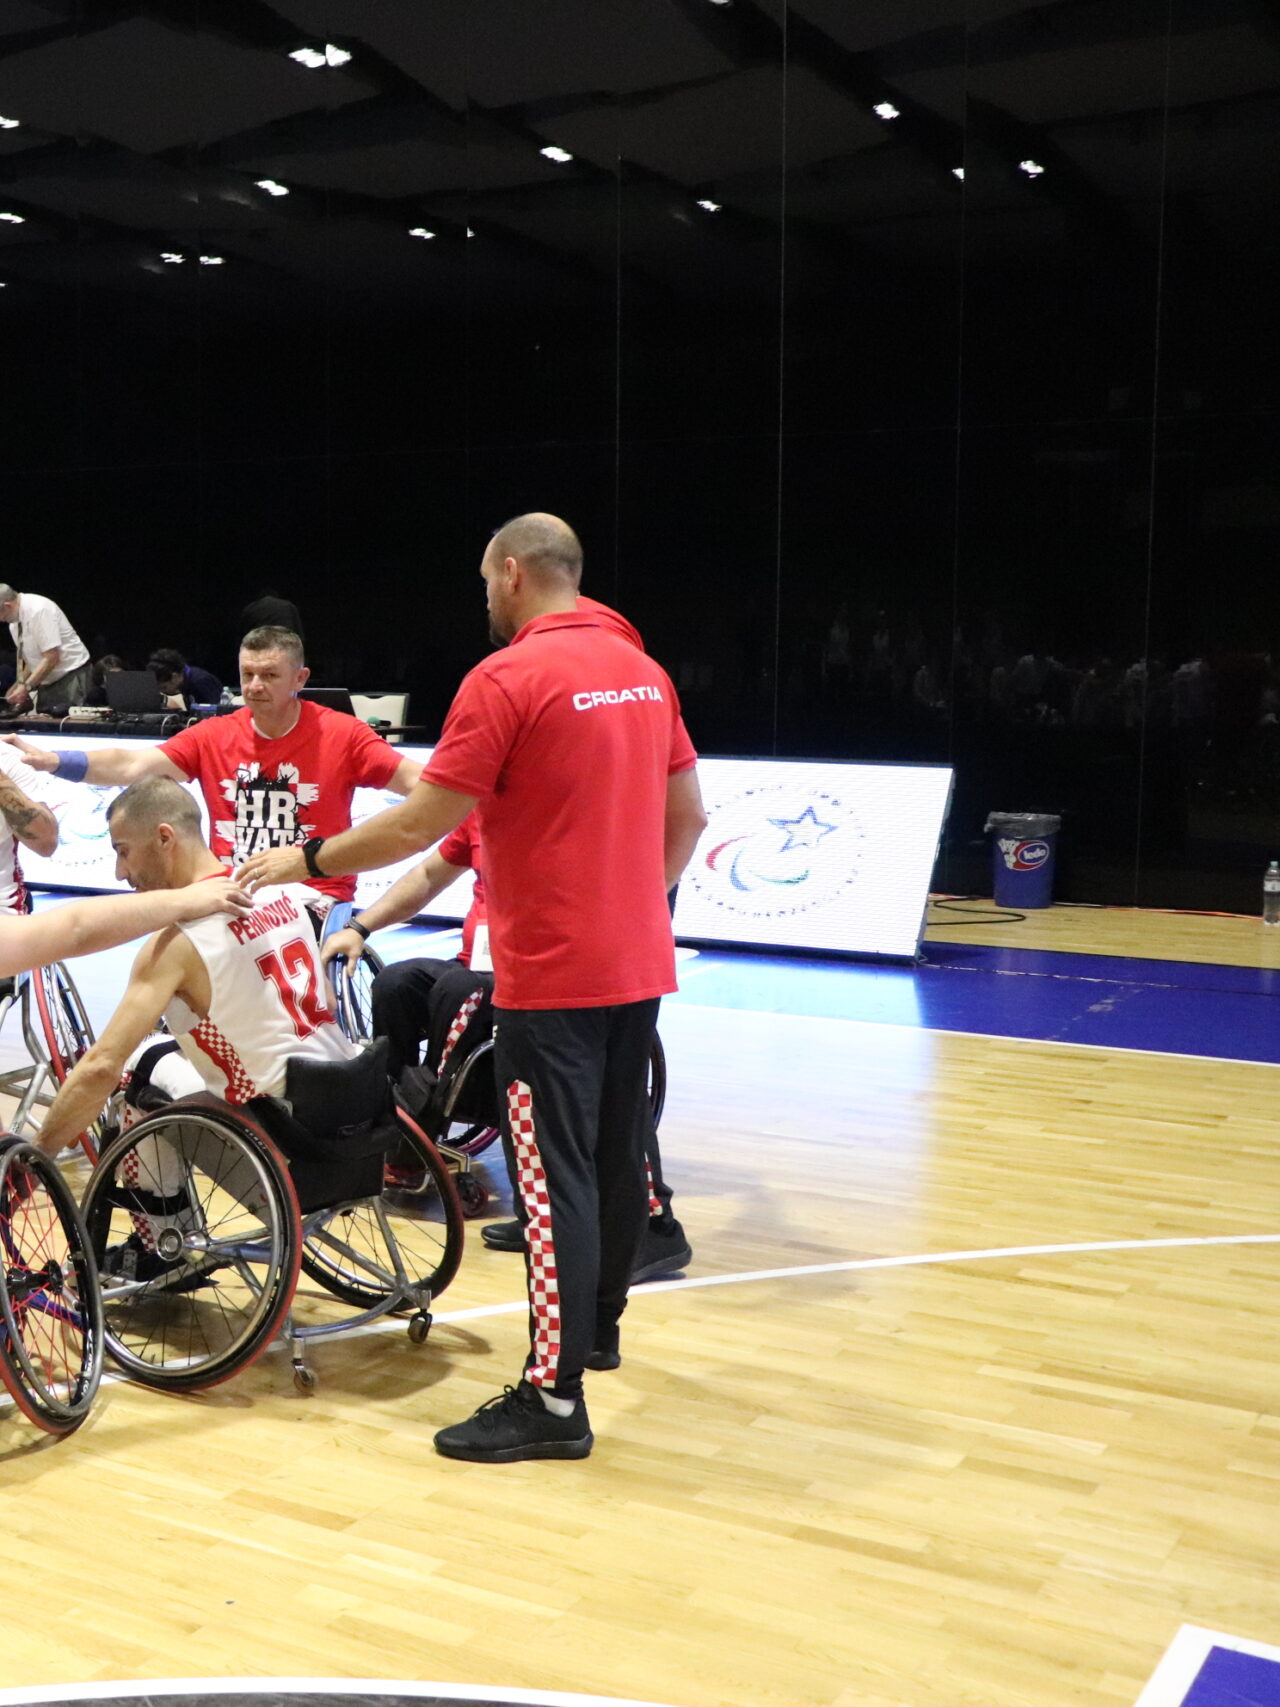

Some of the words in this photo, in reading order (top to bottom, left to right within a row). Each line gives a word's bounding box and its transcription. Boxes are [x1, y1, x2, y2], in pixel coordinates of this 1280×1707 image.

[573, 686, 664, 711] CROATIA
[236, 790, 296, 829] HR
[254, 937, 337, 1041] 12
